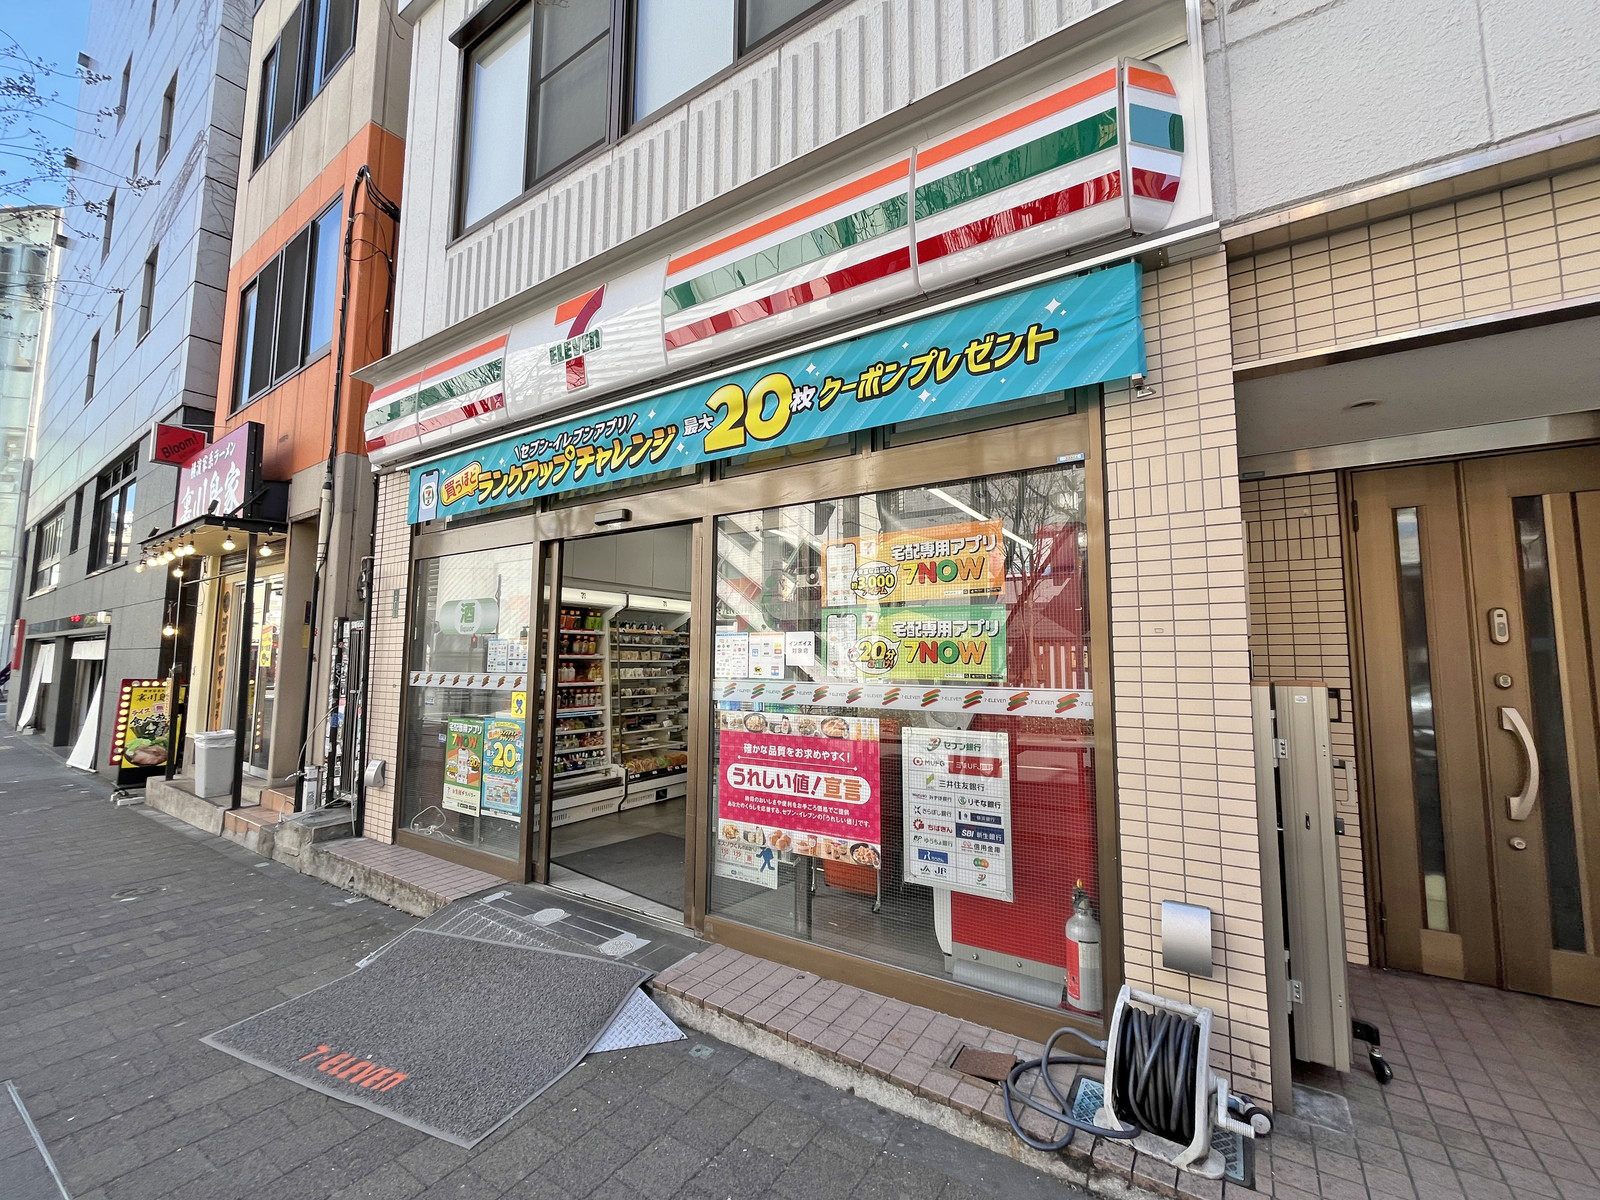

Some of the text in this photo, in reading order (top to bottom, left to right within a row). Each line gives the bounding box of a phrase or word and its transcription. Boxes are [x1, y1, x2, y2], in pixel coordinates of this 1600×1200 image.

[703, 372, 793, 453] 20
[819, 325, 1057, 410] クーポンプレゼント
[161, 434, 199, 459] Bloom!
[444, 426, 679, 503] 買うほど ランクアップチャレンジ
[891, 534, 997, 561] 宅配専用アプリ
[902, 556, 986, 585] 7NOW
[460, 602, 476, 623] 酒
[892, 620, 1000, 638] 宅配専用アプリ
[904, 640, 988, 665] 7NOW
[492, 742, 516, 768] 20
[743, 743, 850, 763] 確かな品質をお求めやすく!
[943, 741, 982, 752] セブン銀行
[939, 779, 985, 792] 三井住友銀行
[967, 799, 1001, 809] りそな銀行
[961, 829, 975, 838] SBI
